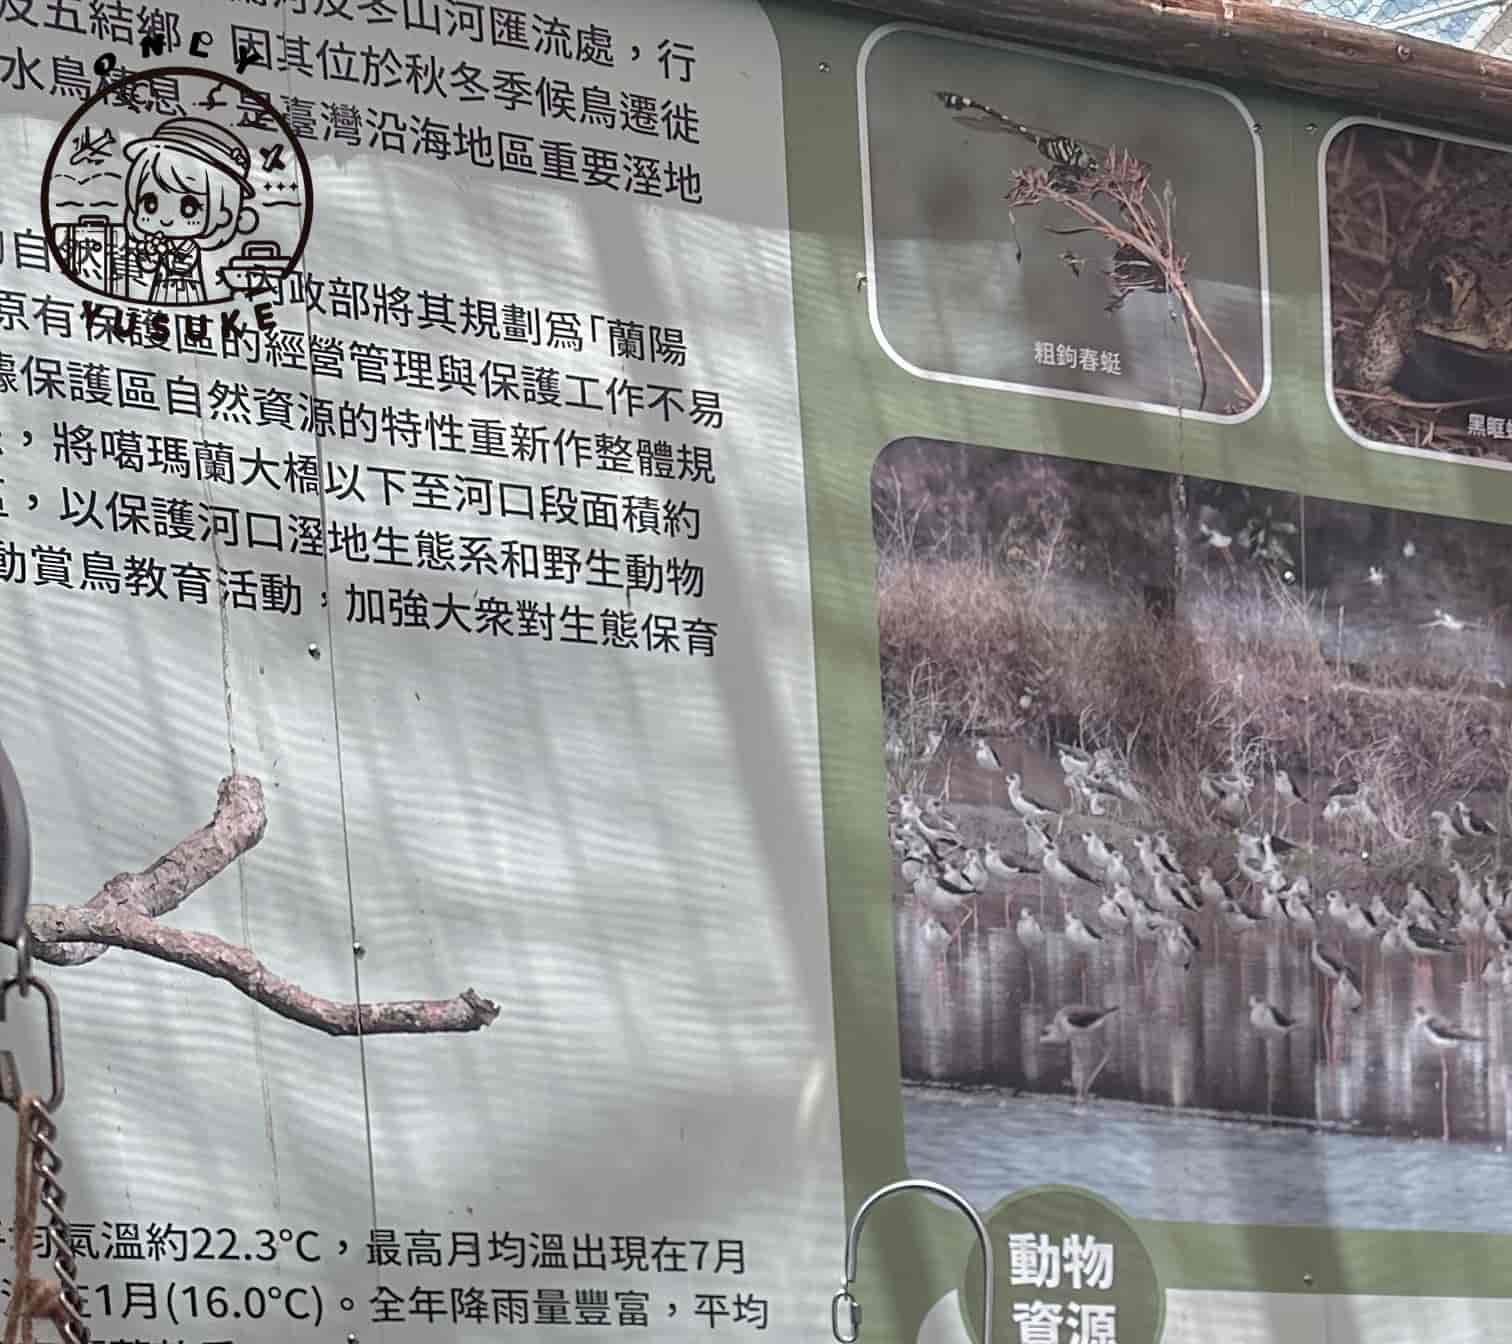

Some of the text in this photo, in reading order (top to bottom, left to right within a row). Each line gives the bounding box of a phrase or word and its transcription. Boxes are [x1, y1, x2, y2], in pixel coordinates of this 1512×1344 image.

[0, 422, 701, 540] ，將噶瑪蘭大橋以下至河口段面積約
[0, 478, 704, 598] ，以保護河口溼地生態系和野生動物
[1008, 1231, 1114, 1289] 動物
